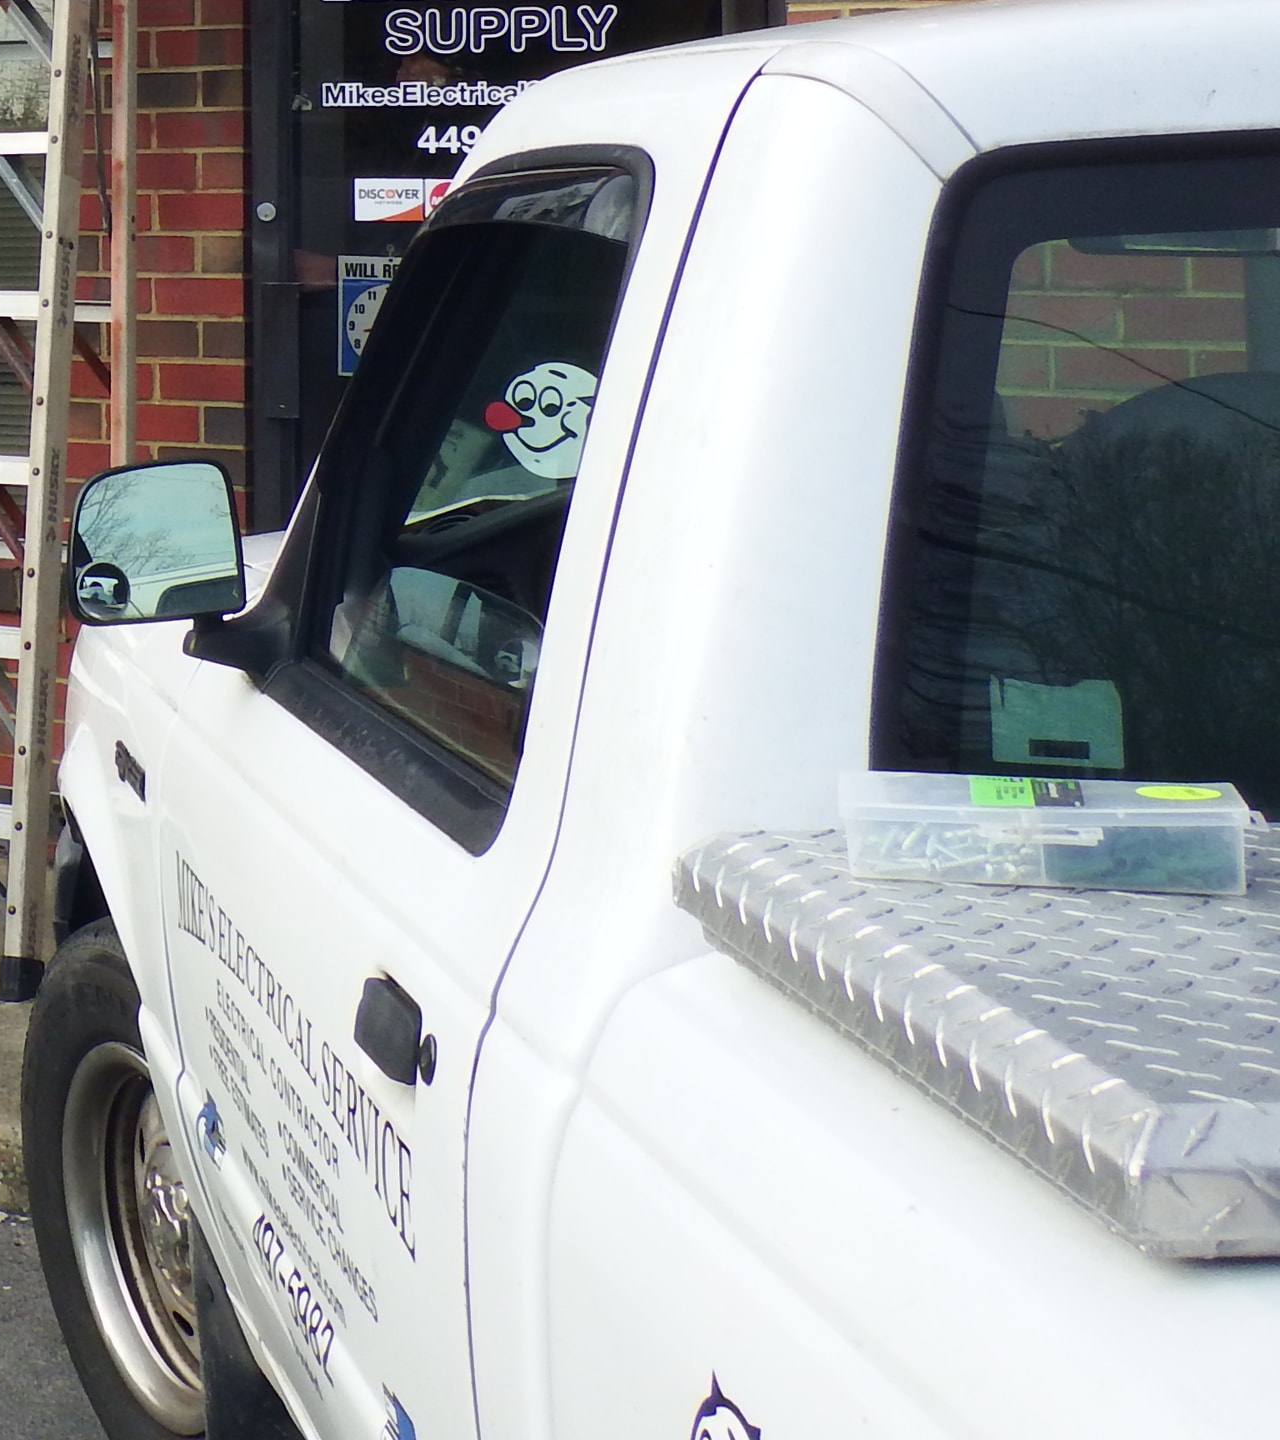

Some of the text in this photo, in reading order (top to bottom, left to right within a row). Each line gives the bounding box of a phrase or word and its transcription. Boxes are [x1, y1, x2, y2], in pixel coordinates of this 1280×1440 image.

[385, 5, 617, 54] SUPPLY
[417, 125, 481, 154] 449
[358, 189, 419, 199] DISCOVER
[345, 262, 378, 278] WILL
[368, 291, 377, 301] 11
[348, 321, 355, 331] 9
[354, 304, 365, 314] 10
[354, 339, 361, 349] 8
[47, 448, 61, 523] HUSKY
[36, 668, 49, 745] HUSKY
[26, 902, 38, 957] USKY
[176, 850, 416, 1263] MIKE'S ELECTRICAL SERVICE
[216, 978, 340, 1179] ELECTRICAL CONTRACTOR
[282, 1129, 344, 1235] COMMERCIAL
[286, 1163, 378, 1323] SERVICE CHANGES
[252, 1211, 334, 1388] 497-5982
